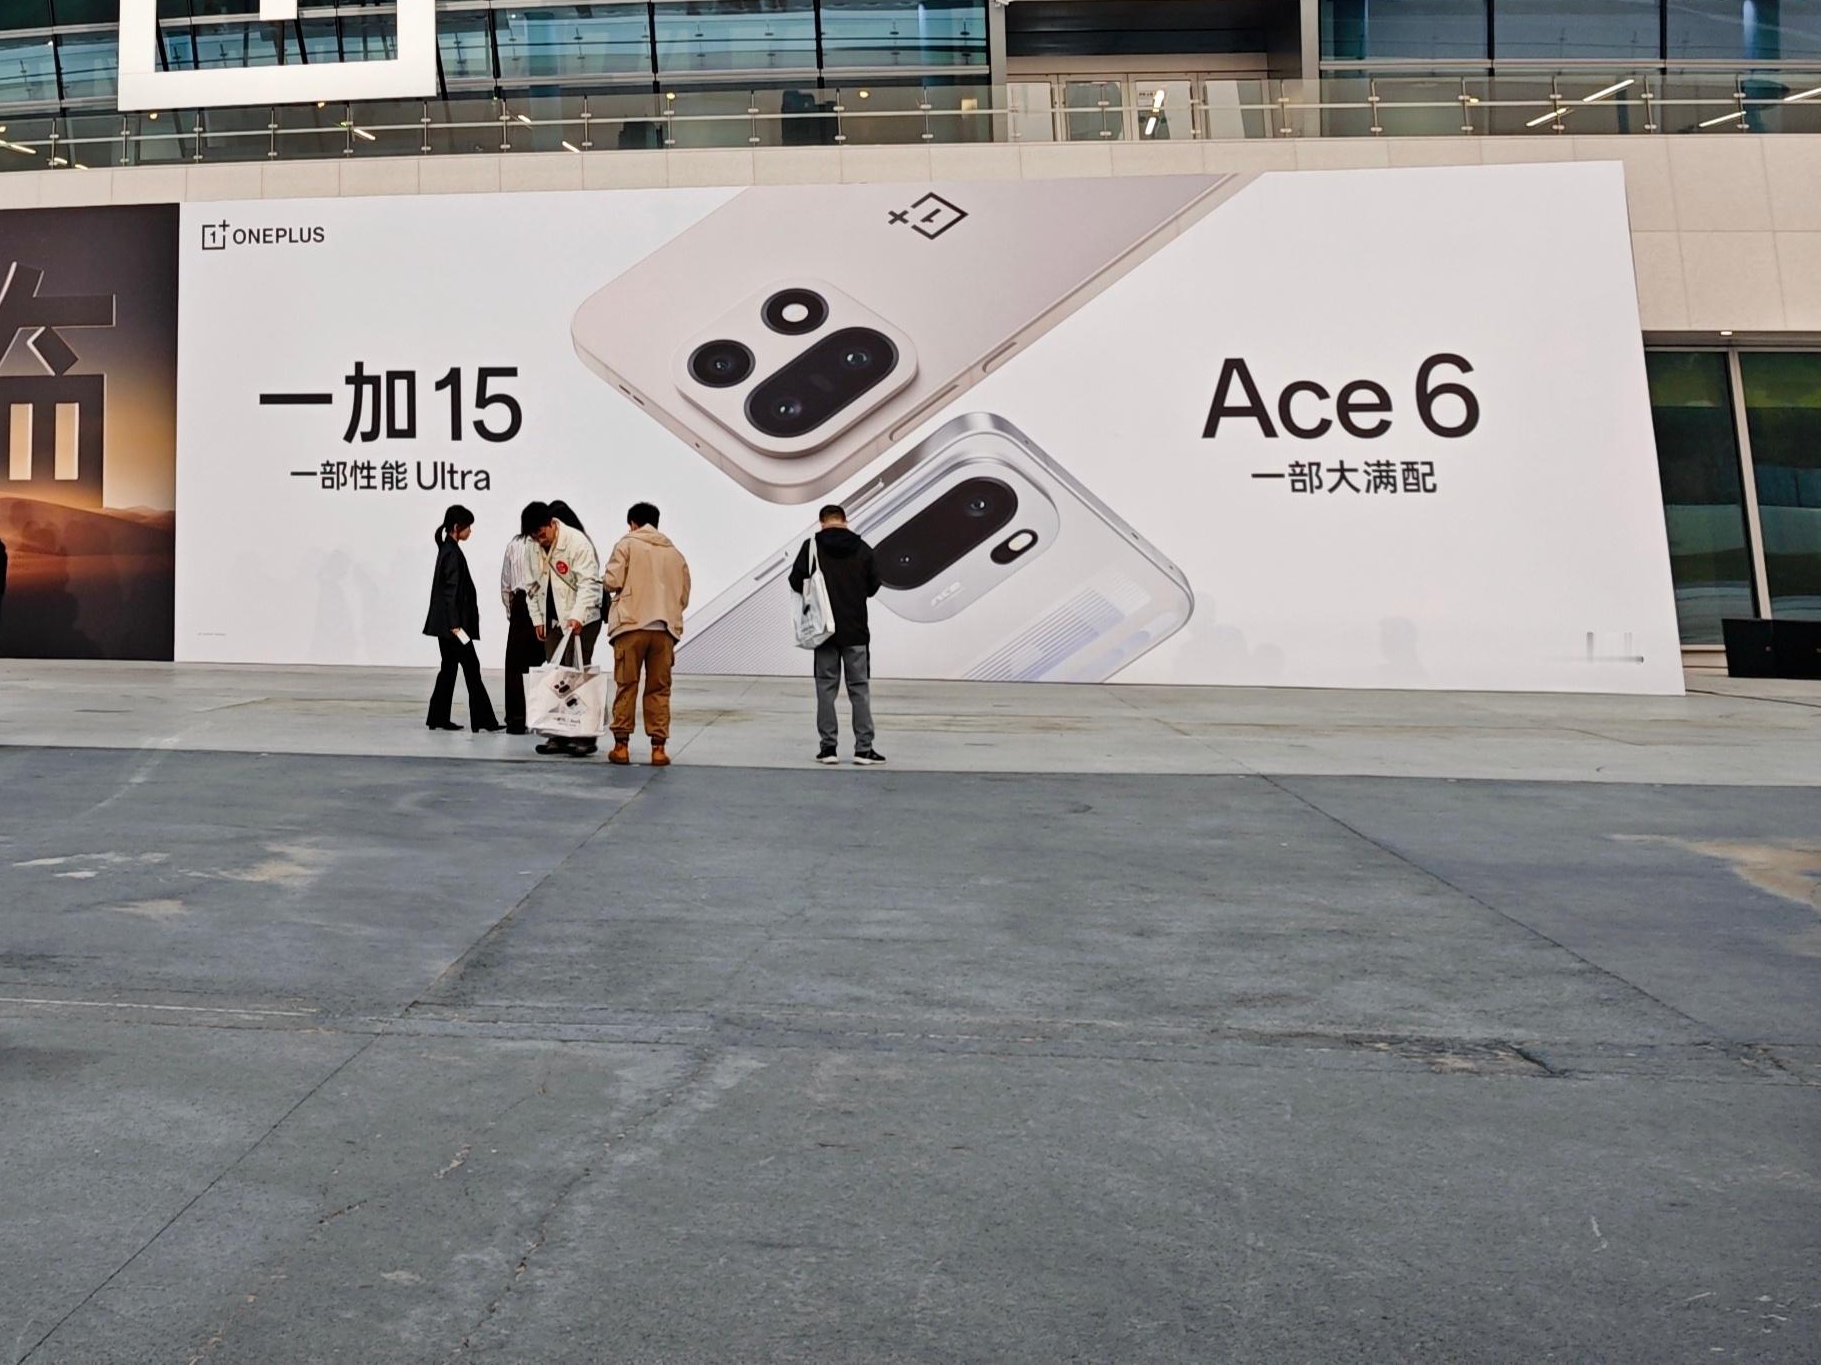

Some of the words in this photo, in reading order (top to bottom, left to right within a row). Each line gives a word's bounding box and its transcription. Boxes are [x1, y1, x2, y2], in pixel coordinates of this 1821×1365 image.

[232, 225, 326, 245] ONEPLUS
[1201, 356, 1393, 440] Ace
[1415, 352, 1480, 439] 6
[289, 459, 408, 492] 一部性能
[416, 461, 491, 491] Ultra
[1250, 459, 1438, 495] 一部大满配
